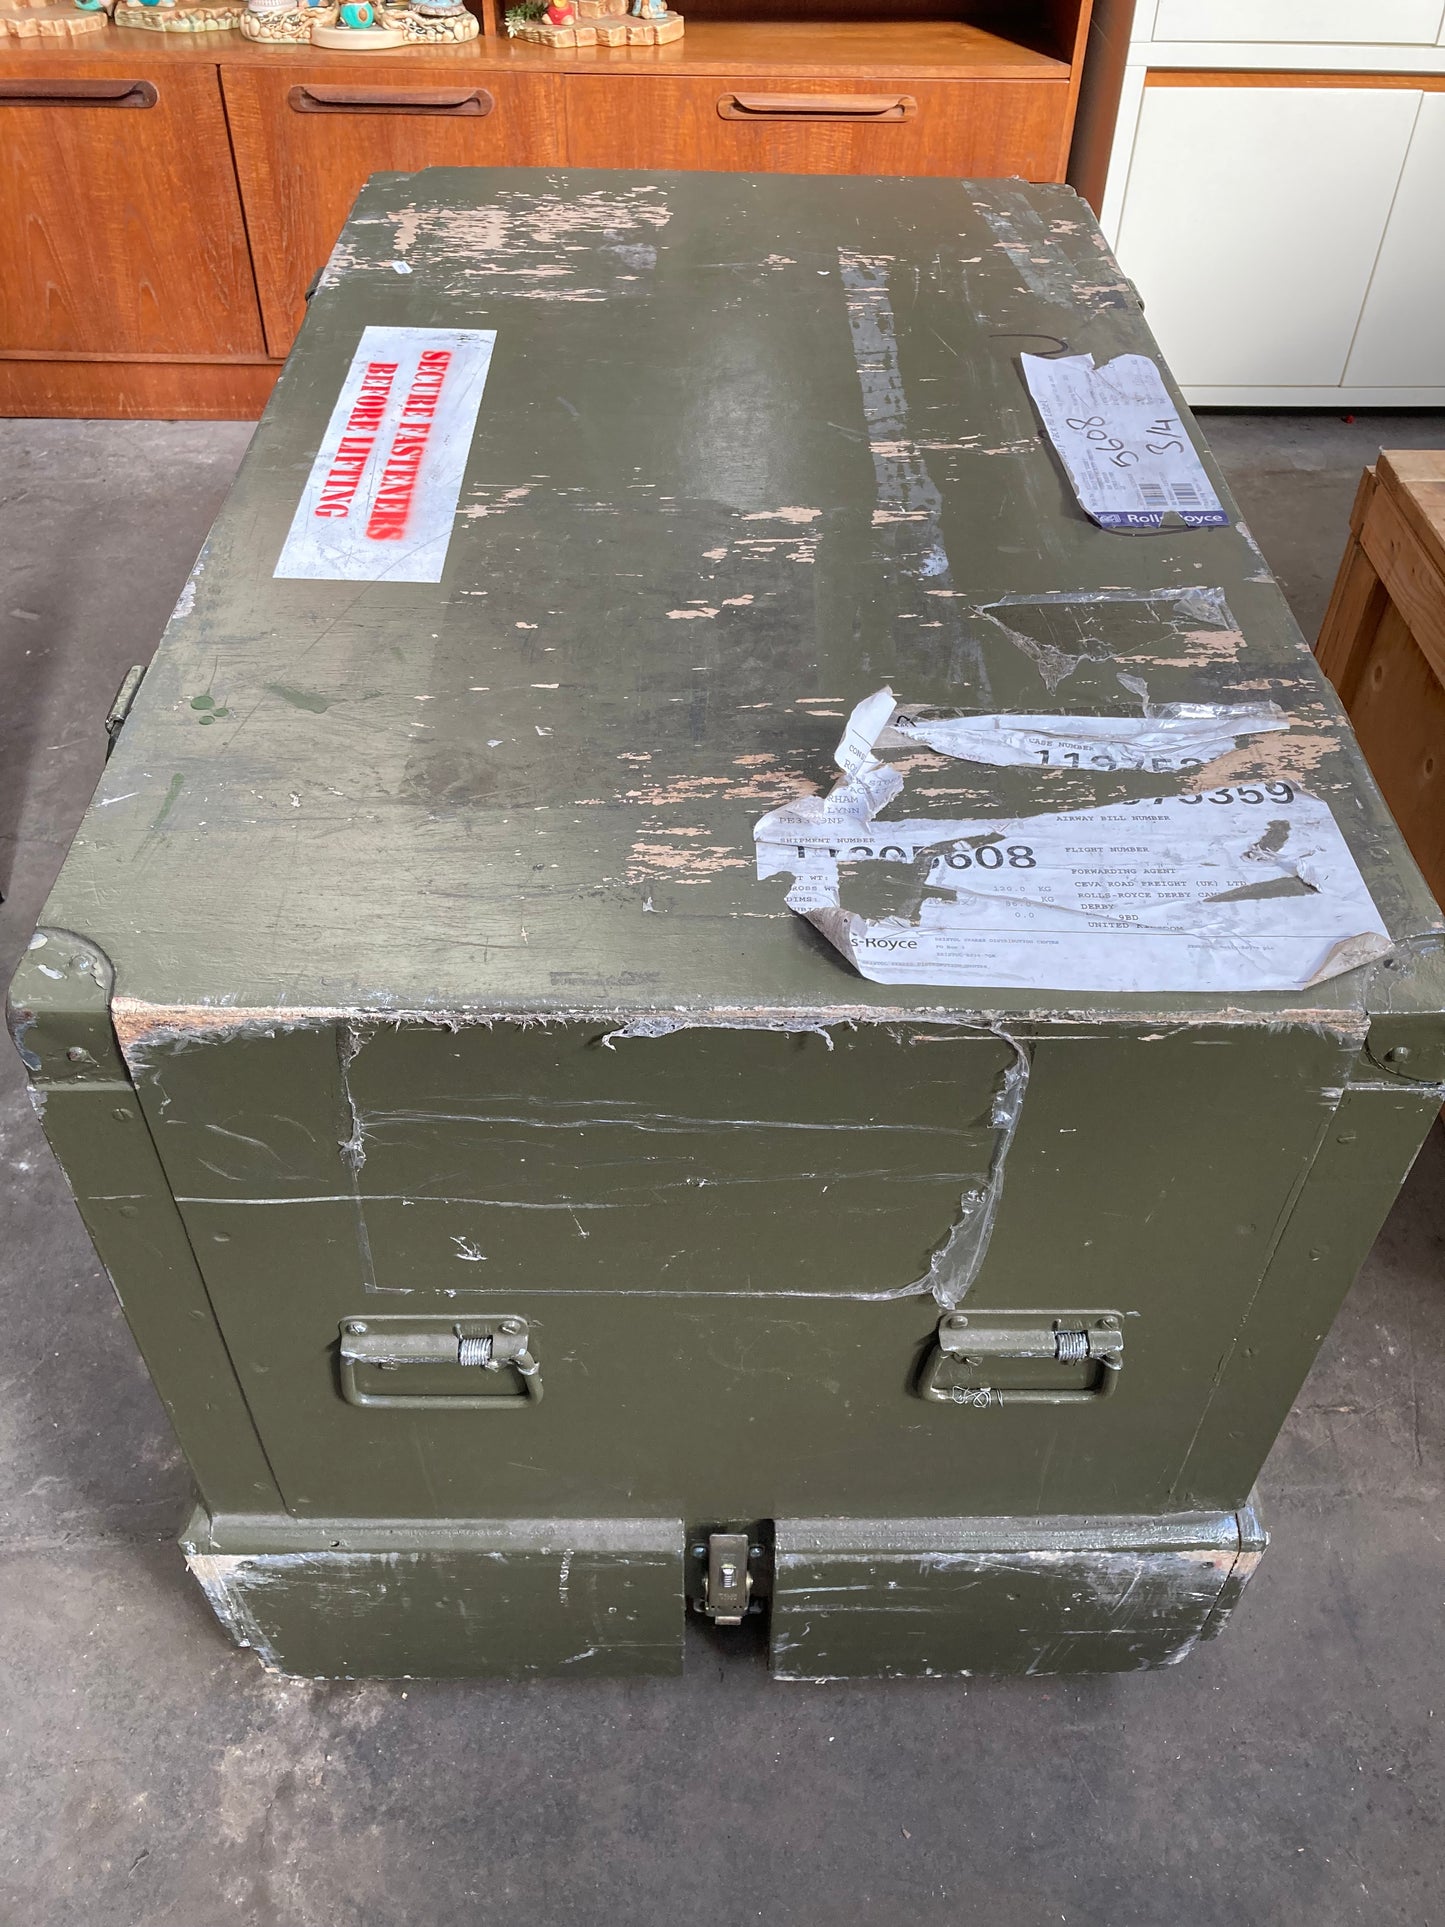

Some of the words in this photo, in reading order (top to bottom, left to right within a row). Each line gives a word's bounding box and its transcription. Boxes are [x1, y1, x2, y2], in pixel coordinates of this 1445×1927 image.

[346, 362, 399, 431] BEFORE
[402, 350, 451, 418] SECURE
[1066, 416, 1139, 467] 5608
[1146, 418, 1184, 455] 3/4
[314, 437, 375, 518] LIFTING
[366, 422, 431, 540] FASTENERS
[1028, 738, 1053, 747] CASE
[1058, 742, 1095, 751] NUMBER
[1071, 867, 1138, 875] FORWARDING
[1074, 880, 1102, 888] CEVA
[1195, 879, 1219, 887] (UK)
[1077, 891, 1152, 899] ROLLS-ROYCE
[1080, 902, 1115, 910] DERBY
[1087, 921, 1130, 929] UNITED
